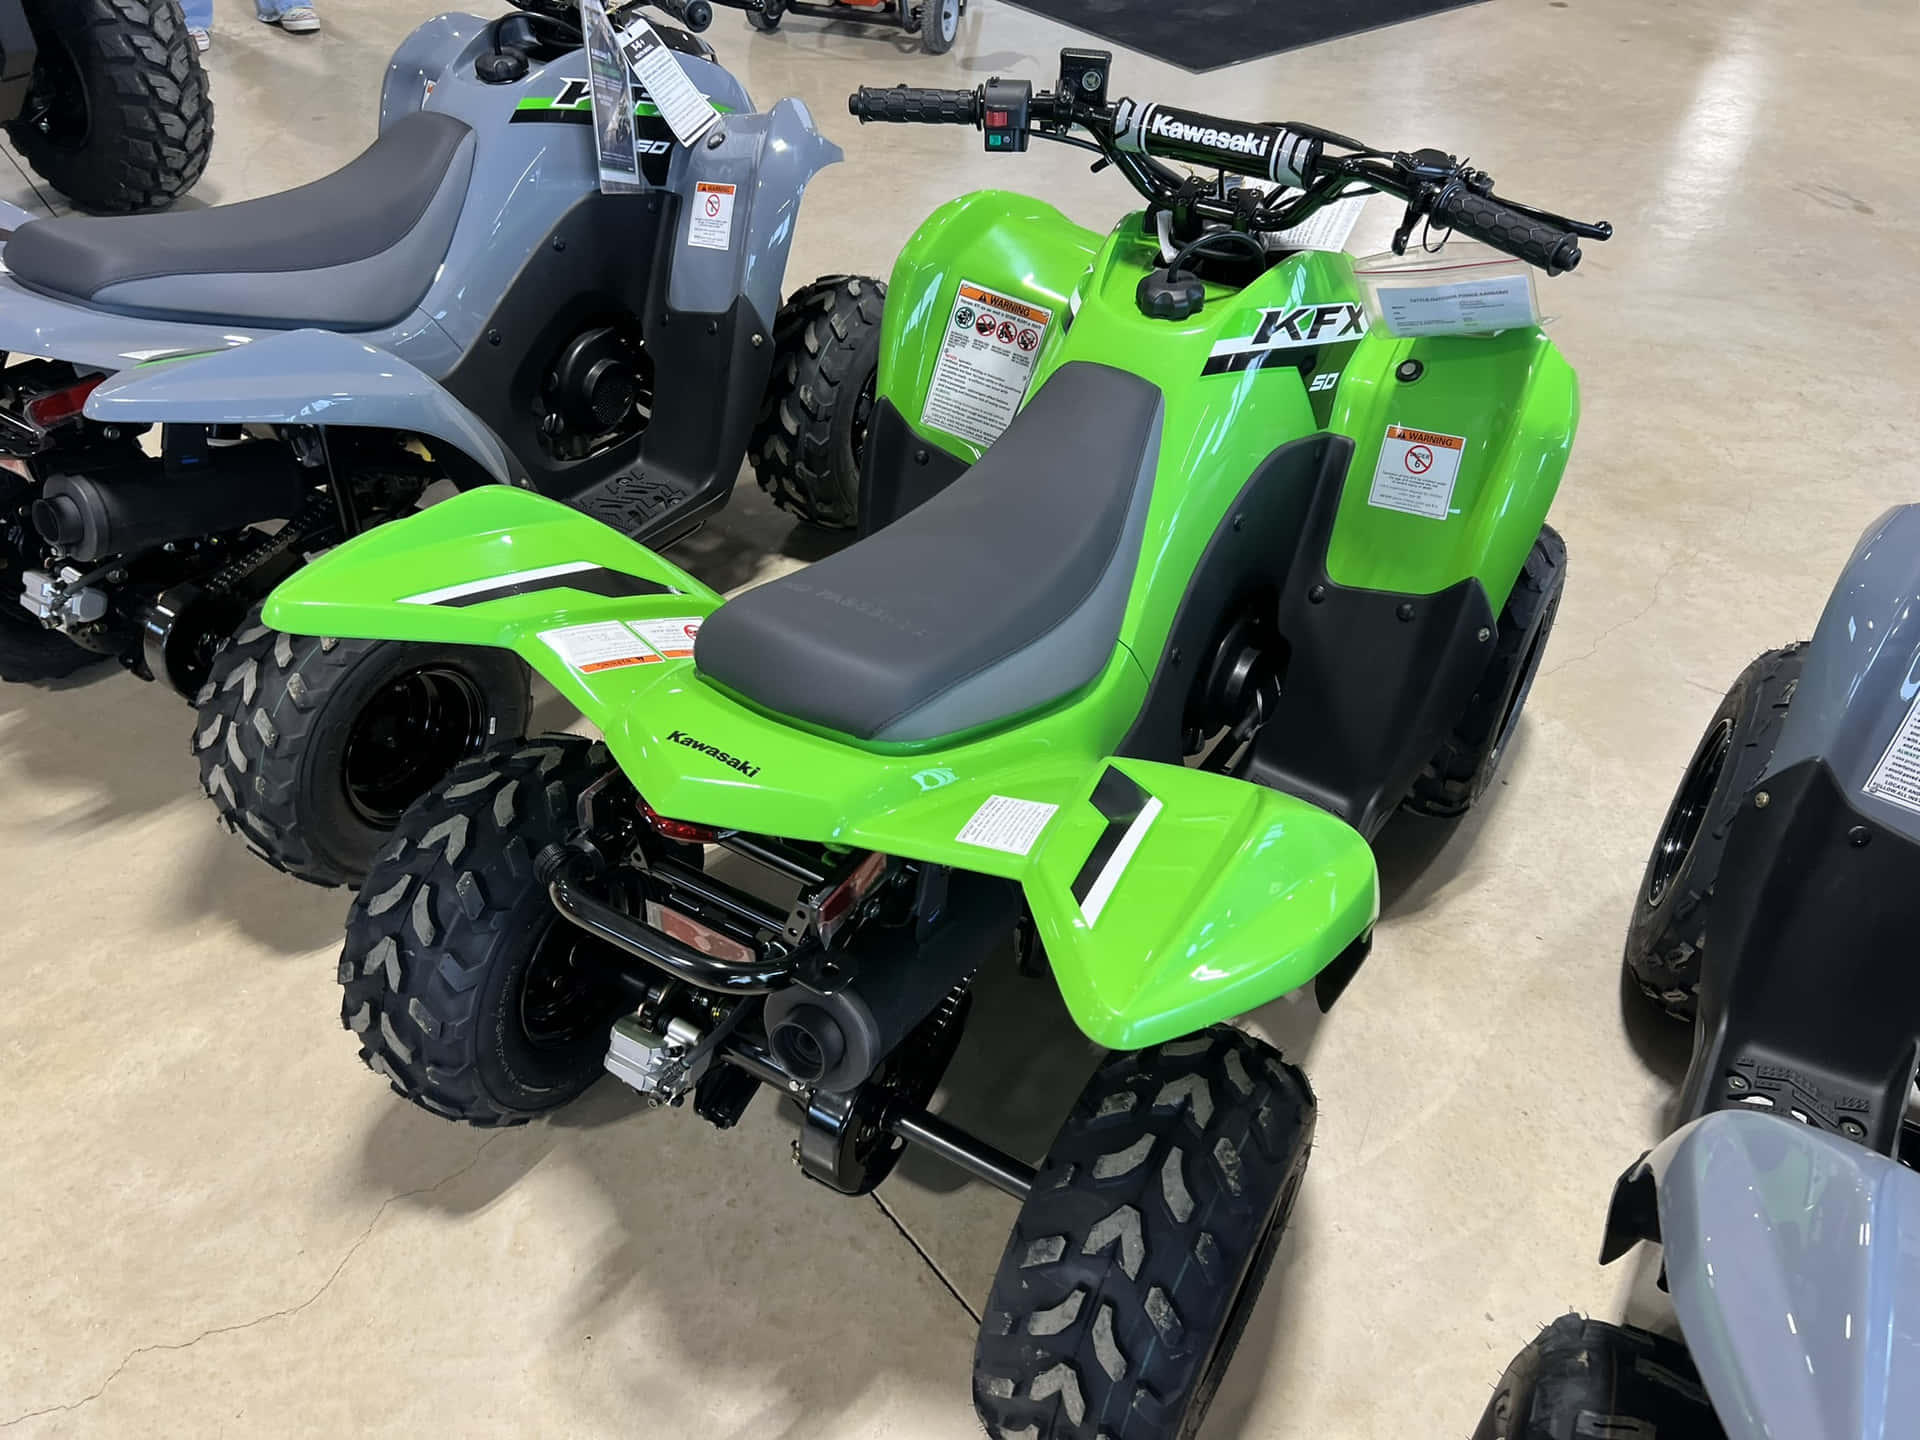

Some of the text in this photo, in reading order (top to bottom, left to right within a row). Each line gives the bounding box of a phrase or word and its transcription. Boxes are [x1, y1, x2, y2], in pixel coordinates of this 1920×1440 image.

[1151, 113, 1270, 157] Kawasaki
[637, 140, 671, 154] 50
[990, 294, 1031, 317] WARNING
[1251, 303, 1364, 345] KFX
[1309, 372, 1340, 391] 50
[1409, 432, 1453, 447] WARNING
[666, 730, 761, 778] Kawasaki
